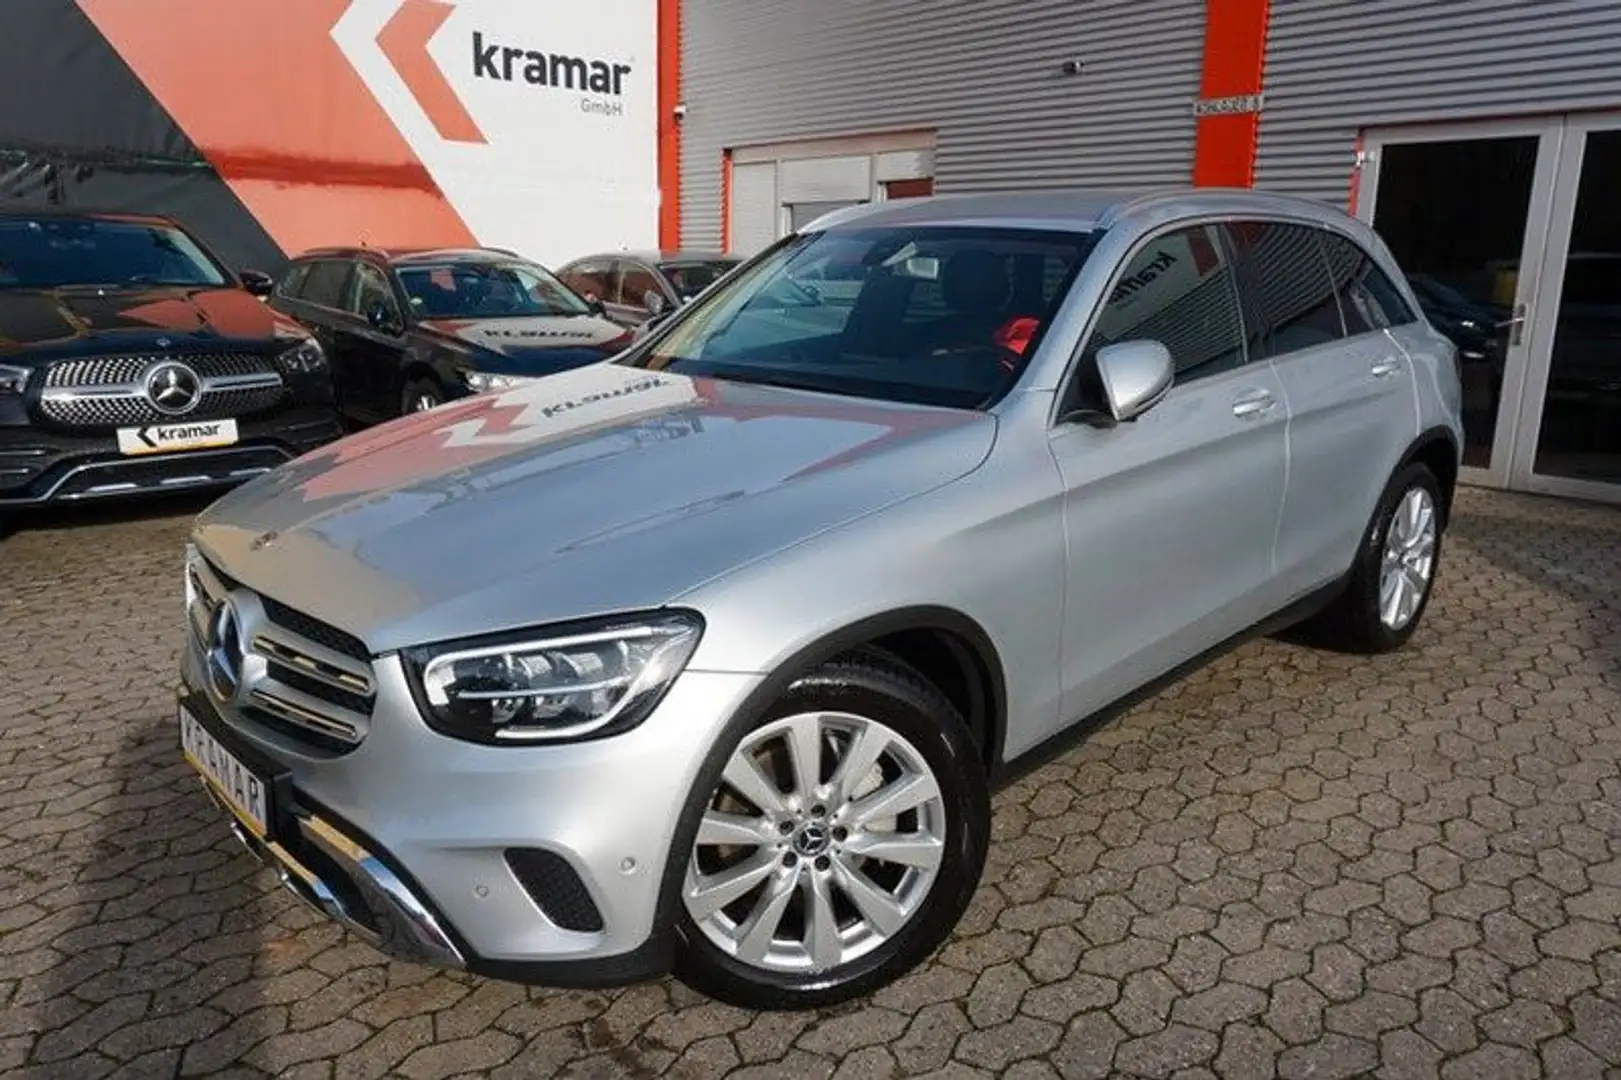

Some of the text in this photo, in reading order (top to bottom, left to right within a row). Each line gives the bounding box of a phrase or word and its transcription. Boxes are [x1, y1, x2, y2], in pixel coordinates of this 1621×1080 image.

[472, 30, 632, 95] kramar
[579, 97, 623, 117] GmbH
[157, 424, 221, 440] kramar
